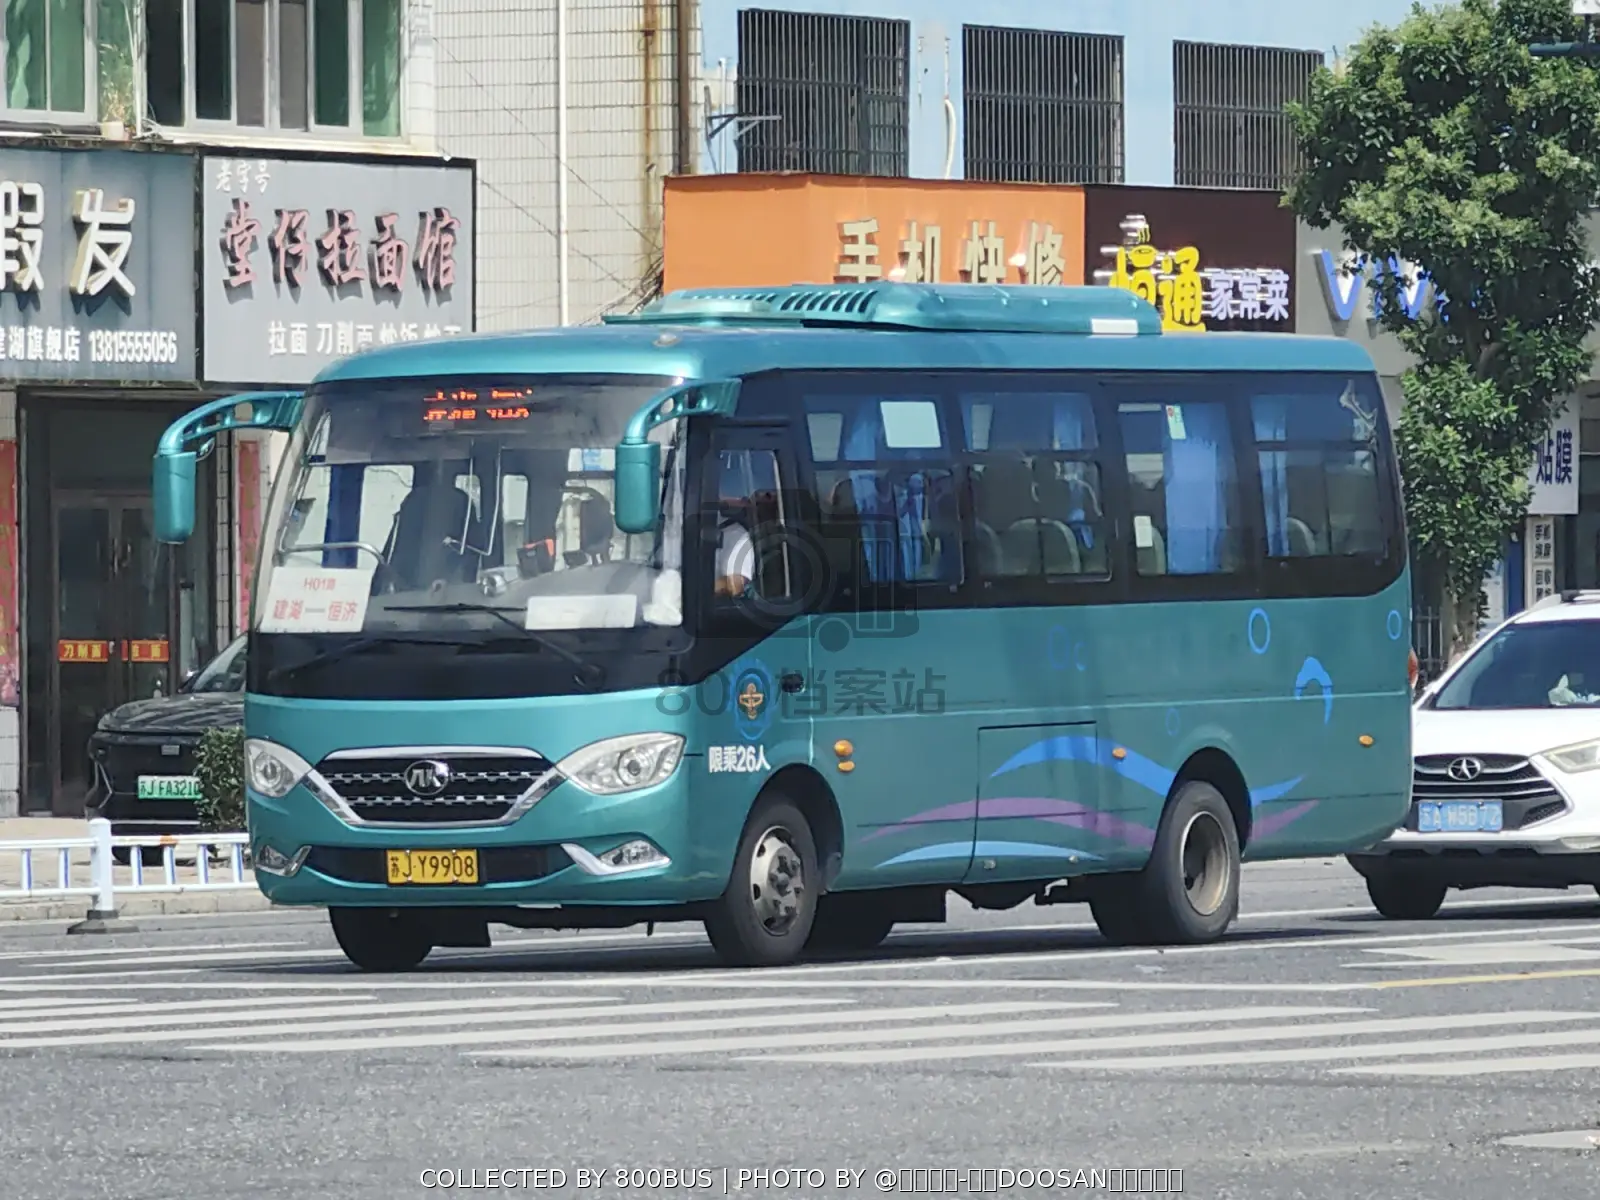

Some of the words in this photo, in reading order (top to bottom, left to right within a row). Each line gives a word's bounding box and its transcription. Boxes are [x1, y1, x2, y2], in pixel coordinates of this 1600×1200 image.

[215, 162, 271, 194] 老字号
[219, 199, 462, 290] 堂仔拉面馆
[1209, 268, 1290, 321] 家常菜
[88, 328, 178, 363] 13815555056
[268, 320, 309, 356] 拉面
[708, 745, 771, 773] 限乘26人
